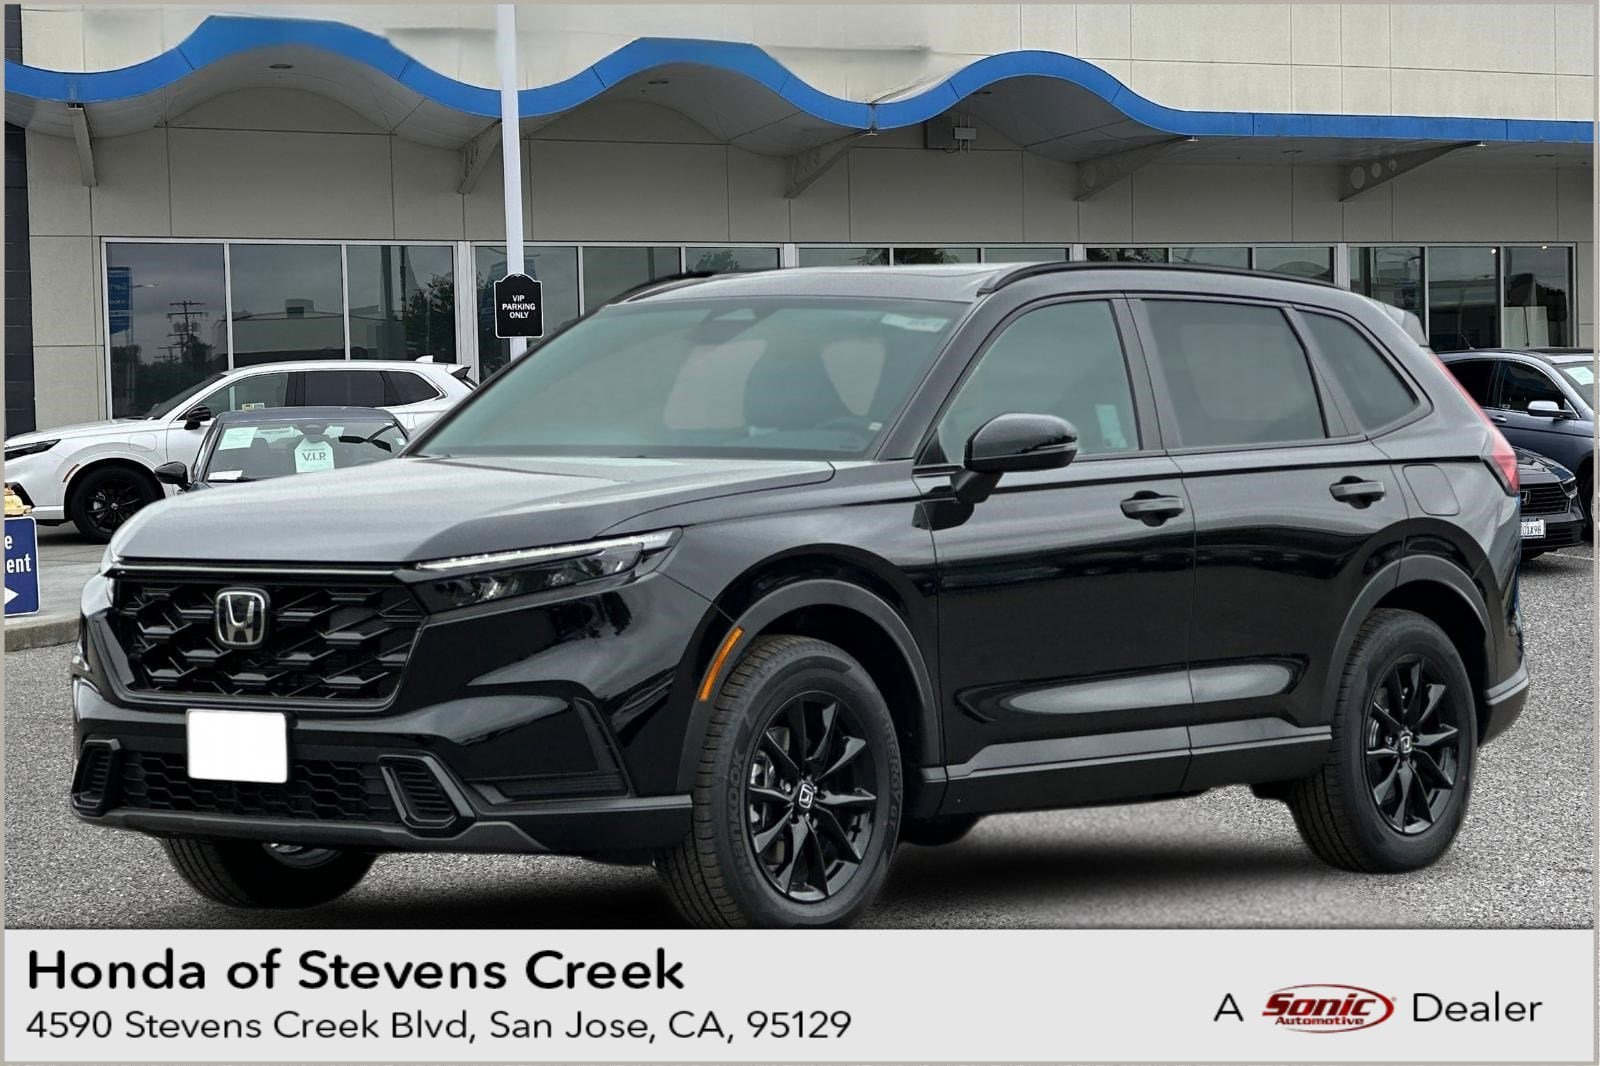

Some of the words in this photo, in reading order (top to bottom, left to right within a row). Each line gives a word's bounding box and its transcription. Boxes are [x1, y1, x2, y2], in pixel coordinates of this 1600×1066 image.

[512, 294, 525, 302] VIP
[502, 303, 536, 311] PARKING
[509, 311, 529, 319] ONLY
[6, 553, 32, 574] ent
